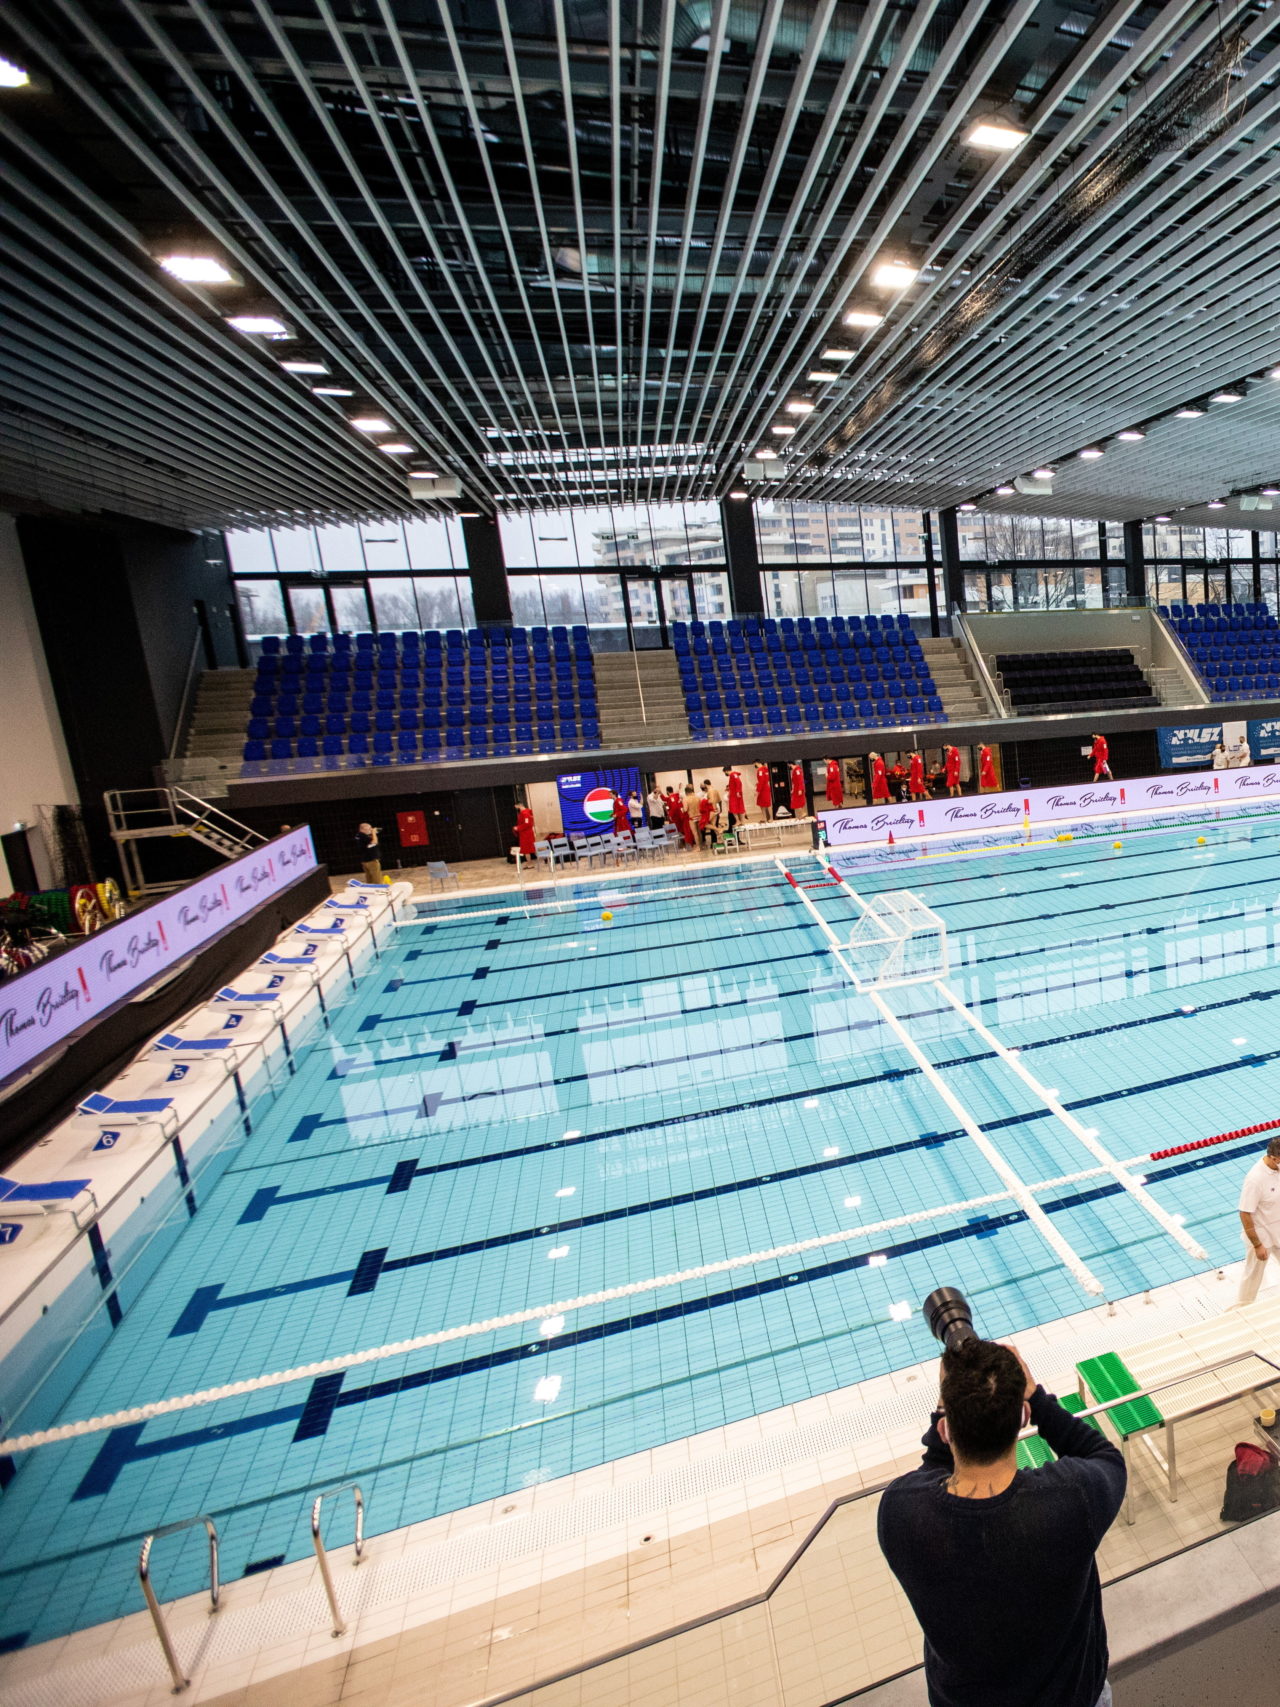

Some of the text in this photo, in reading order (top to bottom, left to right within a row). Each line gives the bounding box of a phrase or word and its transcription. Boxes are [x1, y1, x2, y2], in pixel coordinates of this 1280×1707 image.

[1235, 775, 1260, 790] Thomas
[1146, 784, 1174, 799] Thomas
[1047, 795, 1077, 810] Thomas
[945, 806, 977, 822] Thomas
[833, 817, 868, 834] Thomas
[305, 946, 313, 955] 2
[272, 977, 280, 986] 3
[0, 1008, 36, 1047] Thomas
[229, 1017, 237, 1025] 4
[173, 1067, 185, 1078] 5
[102, 1134, 114, 1146] 6
[1, 1226, 14, 1241] 7
